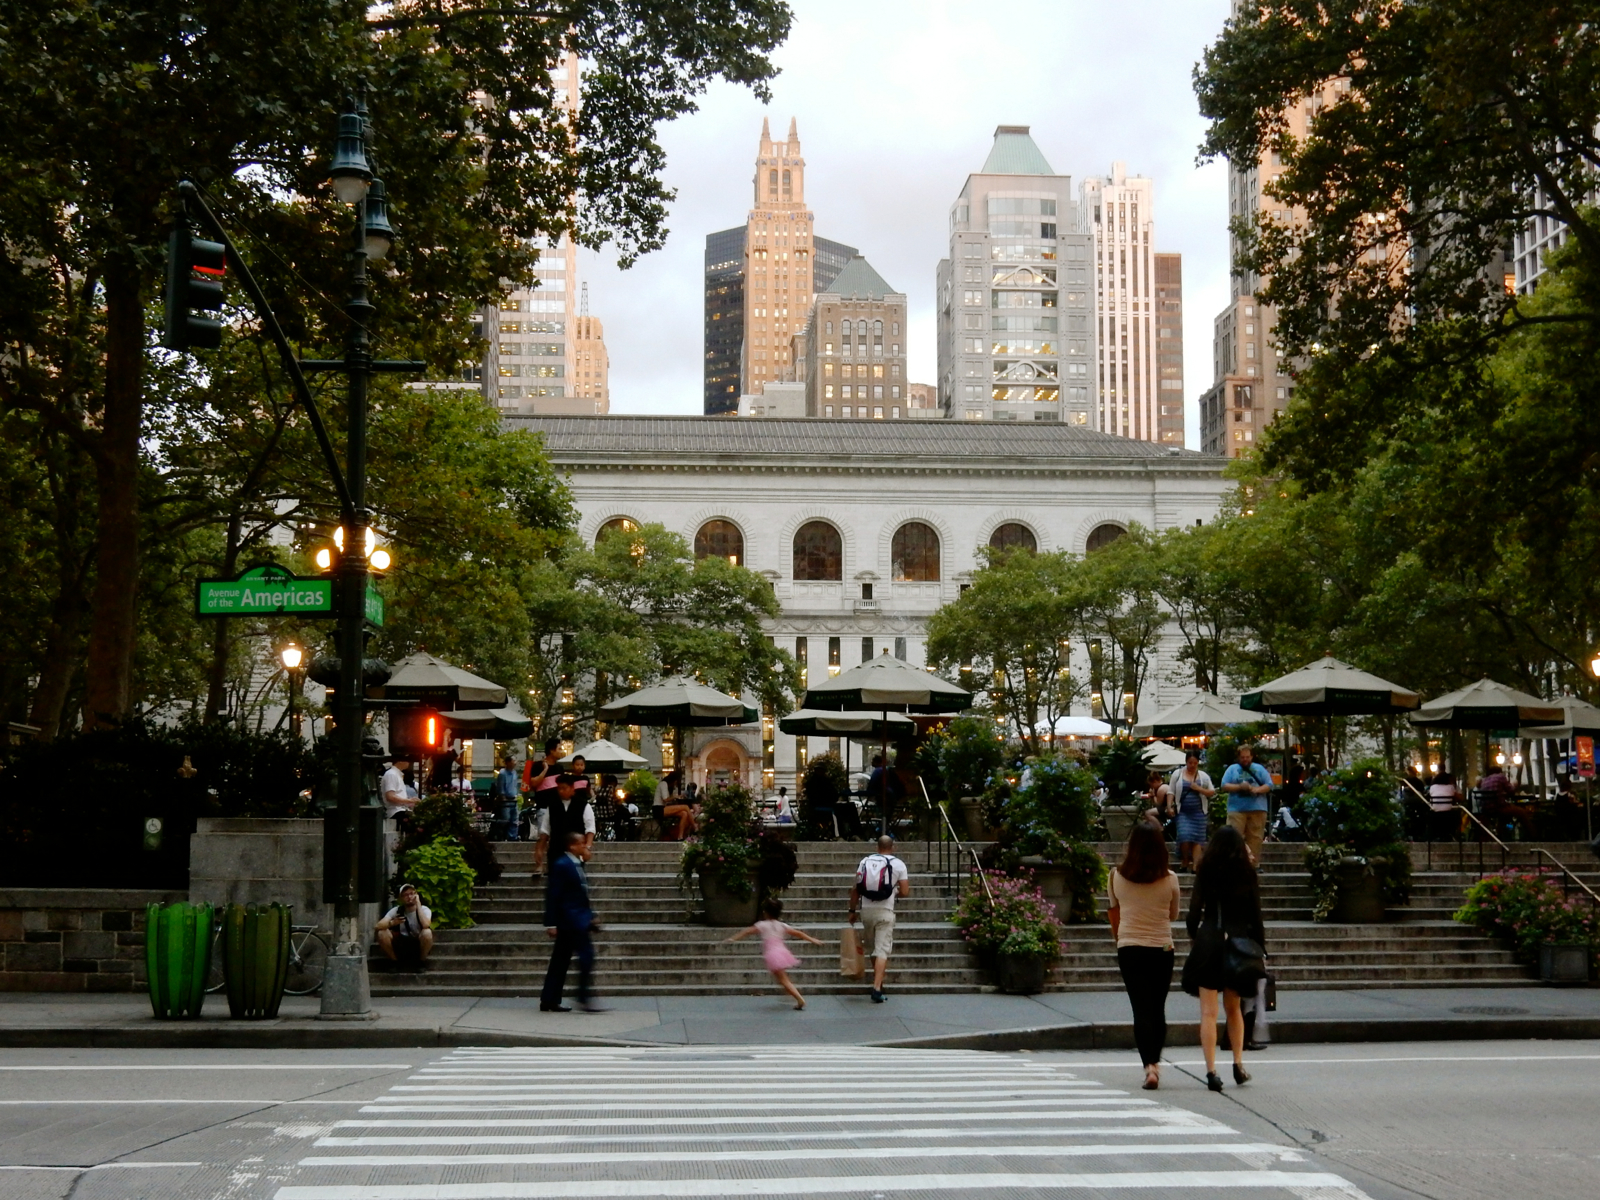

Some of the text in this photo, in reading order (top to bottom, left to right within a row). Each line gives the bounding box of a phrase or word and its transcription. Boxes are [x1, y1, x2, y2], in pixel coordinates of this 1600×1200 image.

[208, 586, 324, 607] Avenue Americas
[208, 598, 233, 608] of the
